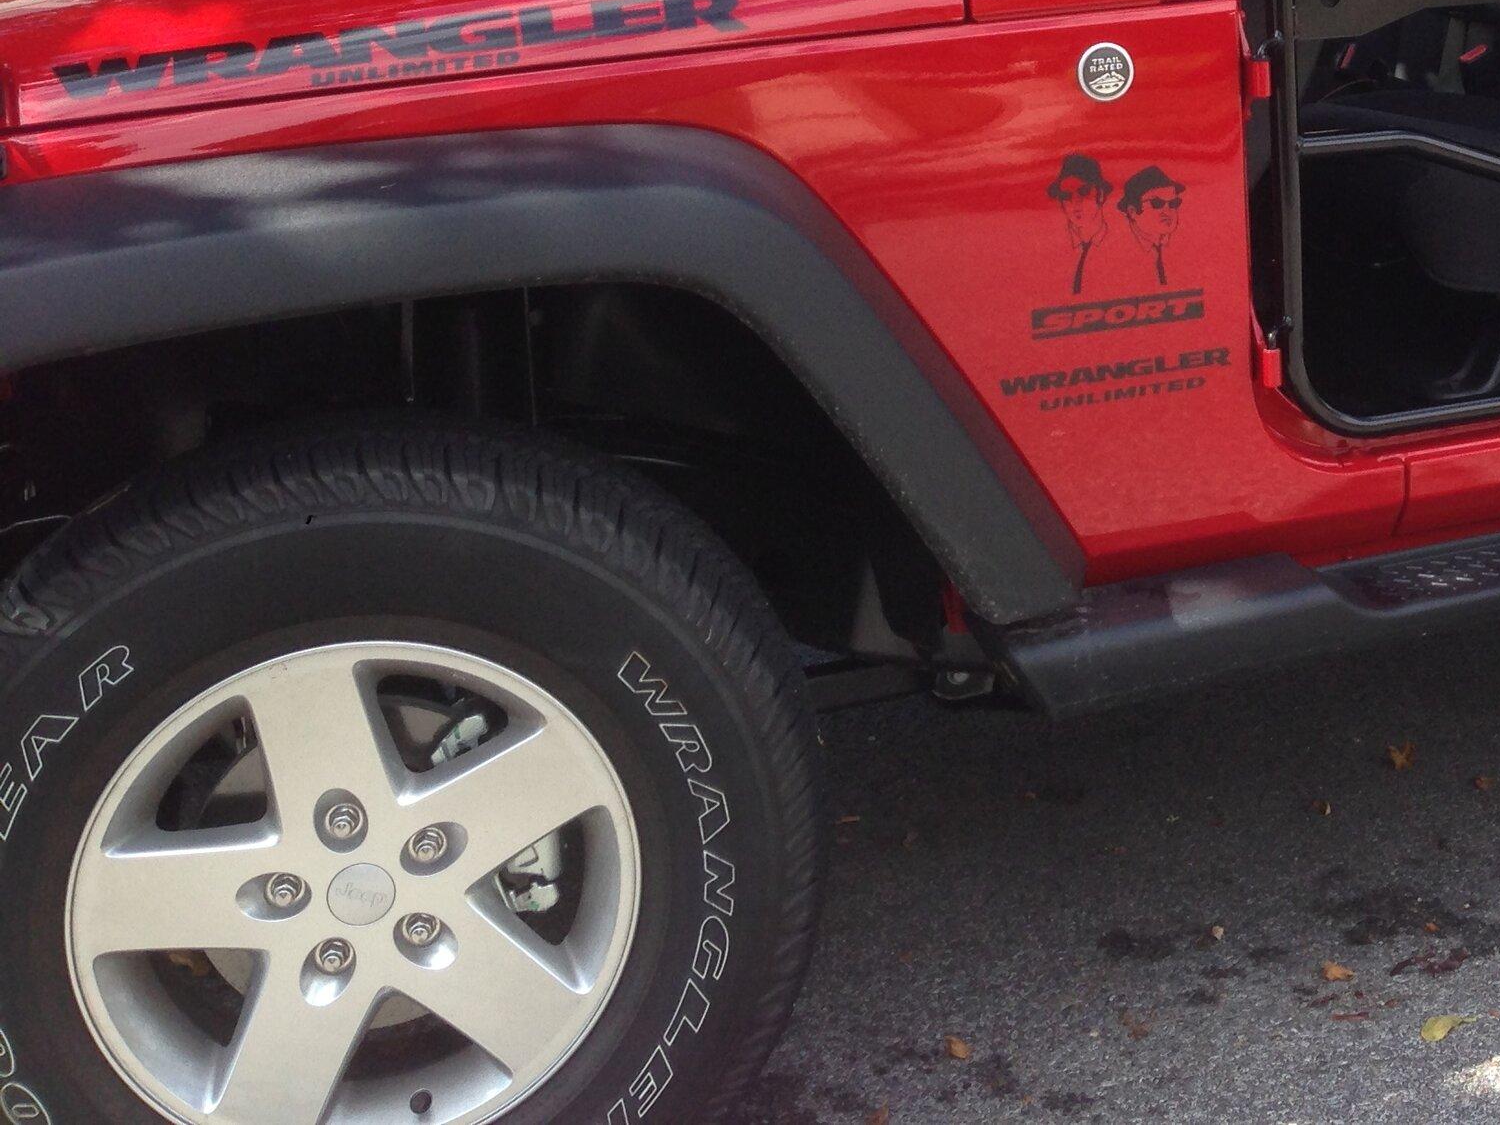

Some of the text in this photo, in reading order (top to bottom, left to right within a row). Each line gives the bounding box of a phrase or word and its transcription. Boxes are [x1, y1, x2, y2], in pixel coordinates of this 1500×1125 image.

[311, 50, 521, 88] UNLIMITED
[1089, 63, 1123, 73] RATED
[1091, 56, 1122, 66] TRAIL
[1036, 297, 1197, 332] SPORT
[1000, 347, 1231, 396] WRANGLER
[1040, 376, 1206, 411] UNLIMITED
